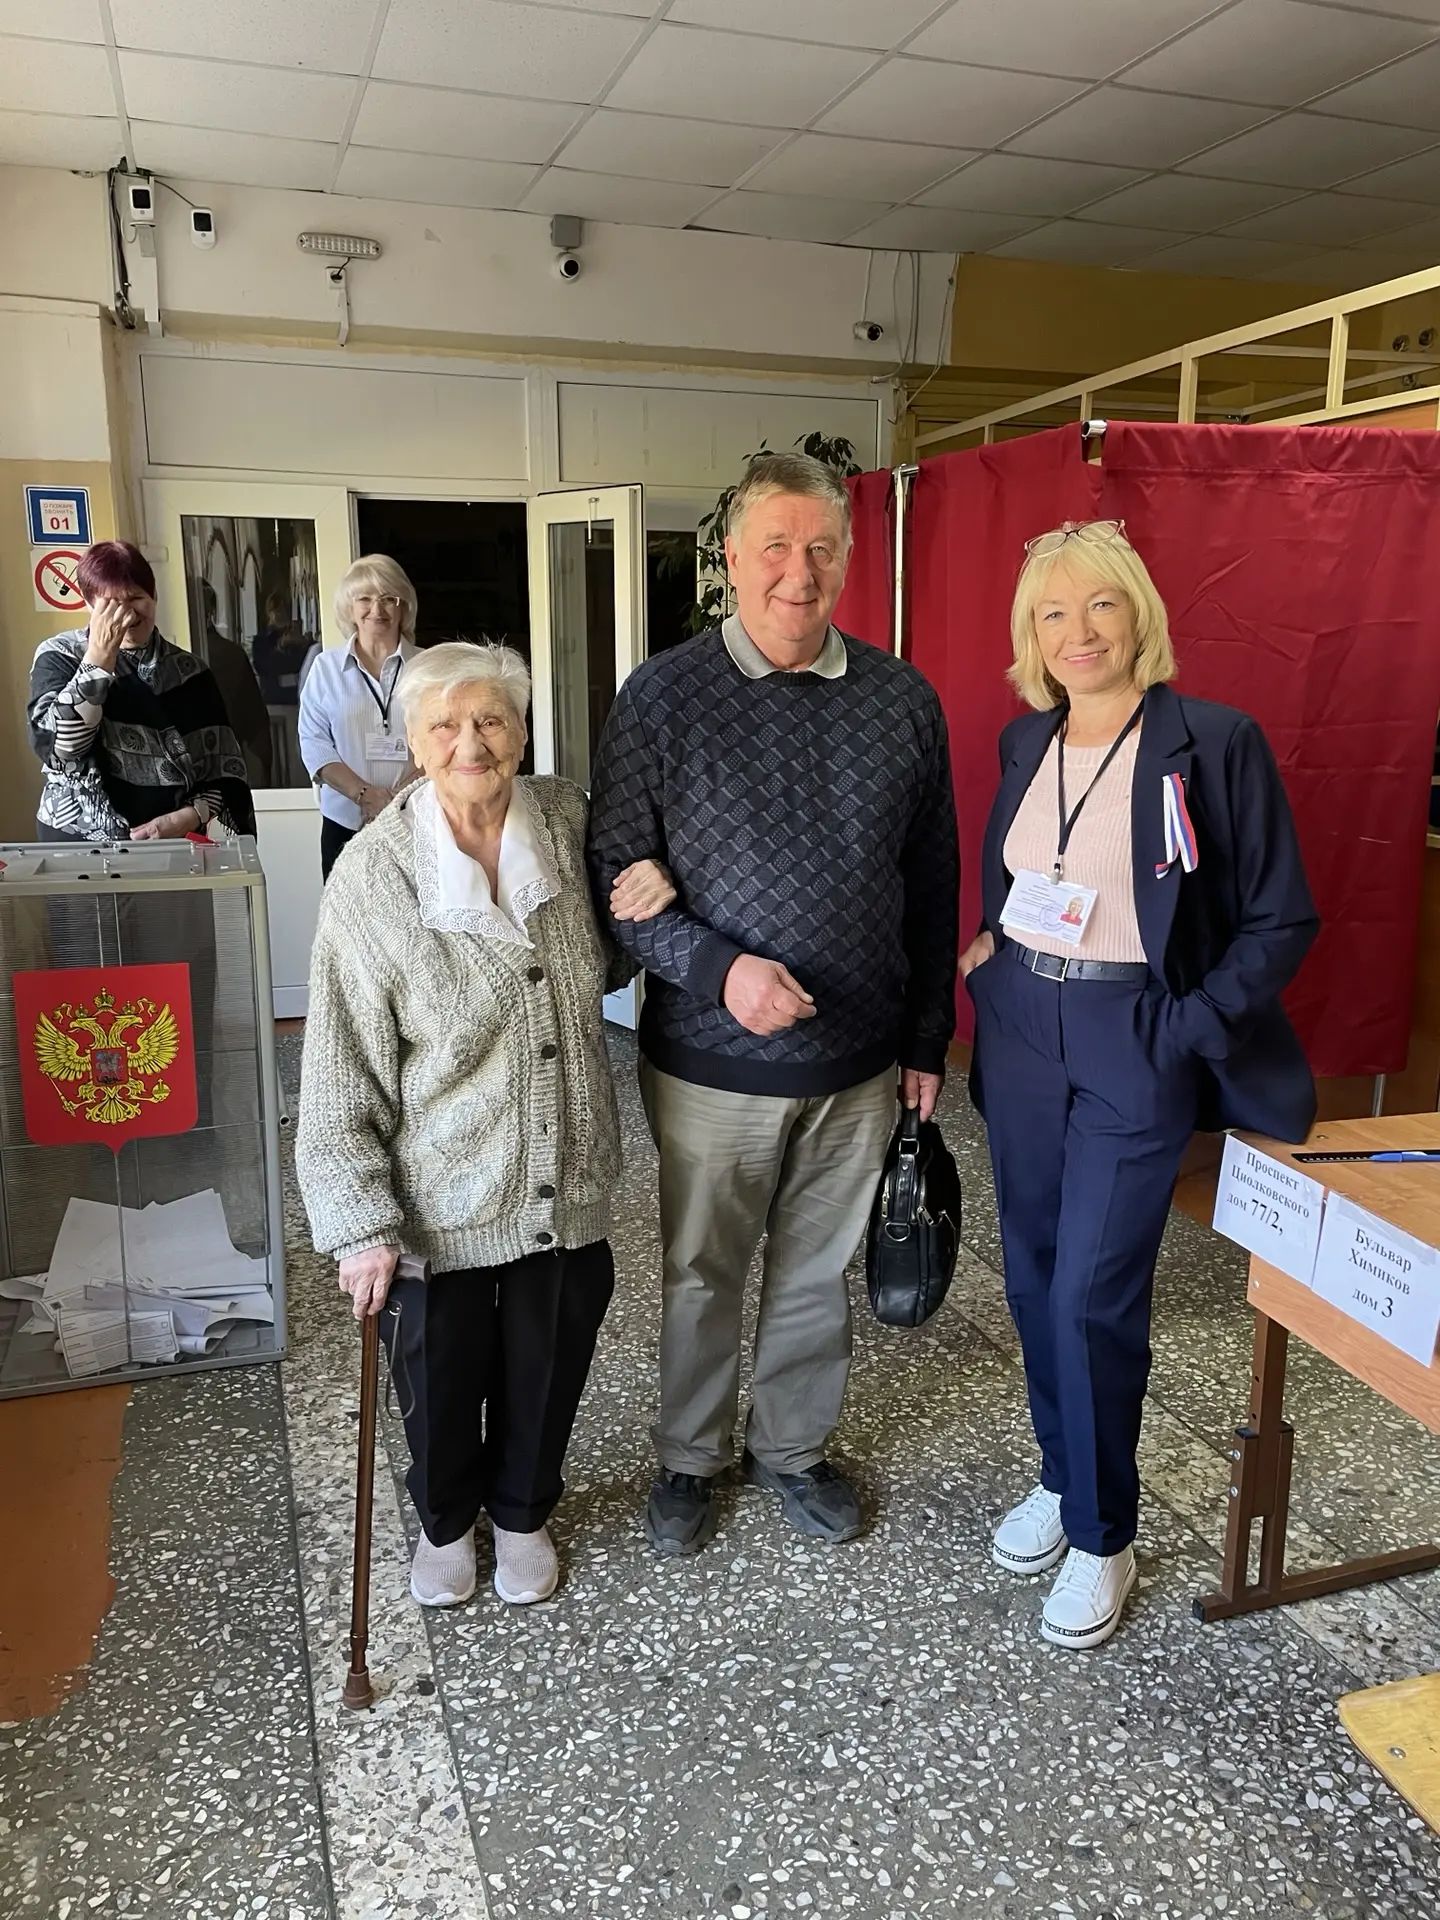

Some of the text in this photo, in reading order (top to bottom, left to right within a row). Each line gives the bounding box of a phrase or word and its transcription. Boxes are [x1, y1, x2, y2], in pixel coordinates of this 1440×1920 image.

[50, 517, 70, 530] 01
[1231, 1164, 1310, 1219] Циолковского
[1246, 1151, 1300, 1190] Проспект
[1226, 1193, 1284, 1237] дом 77/2,
[1348, 1247, 1411, 1295] Химиков
[1355, 1227, 1412, 1273] Бульвар
[1352, 1288, 1394, 1318] дом 3
